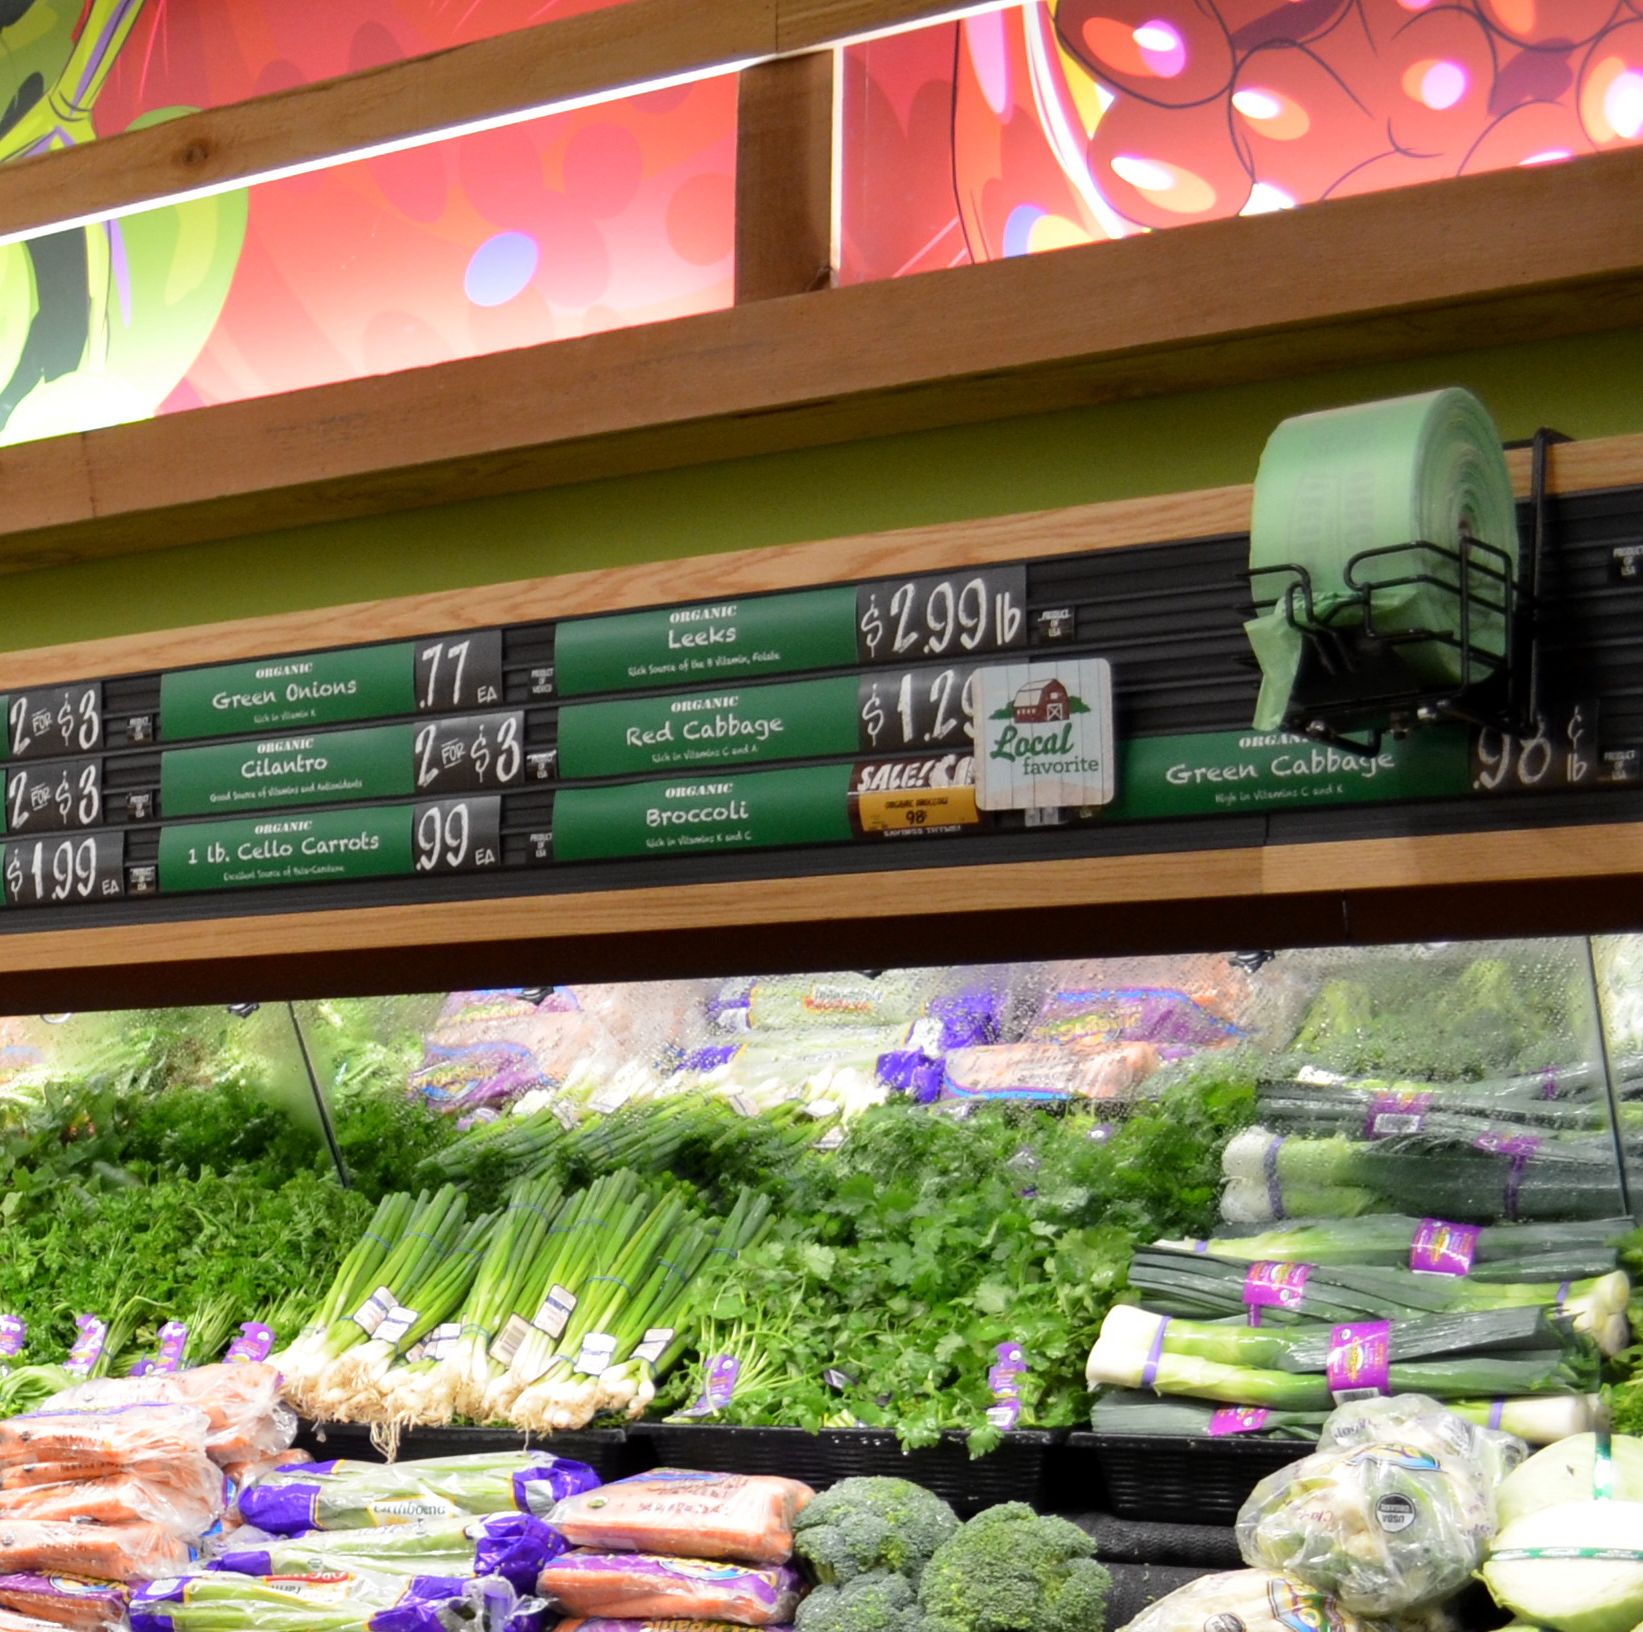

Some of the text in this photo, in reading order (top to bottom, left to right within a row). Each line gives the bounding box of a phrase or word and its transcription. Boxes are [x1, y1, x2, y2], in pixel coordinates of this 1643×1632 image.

[669, 605, 737, 624] ORGANIC
[861, 578, 987, 657] $2.99
[669, 626, 737, 649] Leeks
[256, 662, 313, 679] ORGANIC
[213, 680, 357, 710] Green Onions
[478, 686, 497, 703] EA
[671, 696, 739, 713] ORGANIC
[10, 697, 31, 756] 2
[32, 709, 53, 736] FOR
[627, 712, 784, 747] Red Cabbage
[257, 738, 314, 754] ORGANIC
[990, 723, 1074, 762] Local
[1238, 734, 1310, 749] ORGAN
[241, 754, 328, 779] Cilantro
[416, 724, 438, 787] 2
[441, 738, 466, 769] FOR
[1023, 756, 1099, 775] favorite
[1166, 749, 1395, 786] Green Cabbage
[857, 758, 932, 791] SALE!
[9, 771, 29, 829] 2
[31, 784, 51, 811] FOR
[665, 783, 733, 798] ORGANIC
[646, 801, 749, 827] Broccoli
[255, 821, 312, 835] ORGANIC
[188, 831, 379, 865] 1 lb. Cello Carrots
[475, 848, 495, 865] EA
[102, 879, 119, 895] EA
